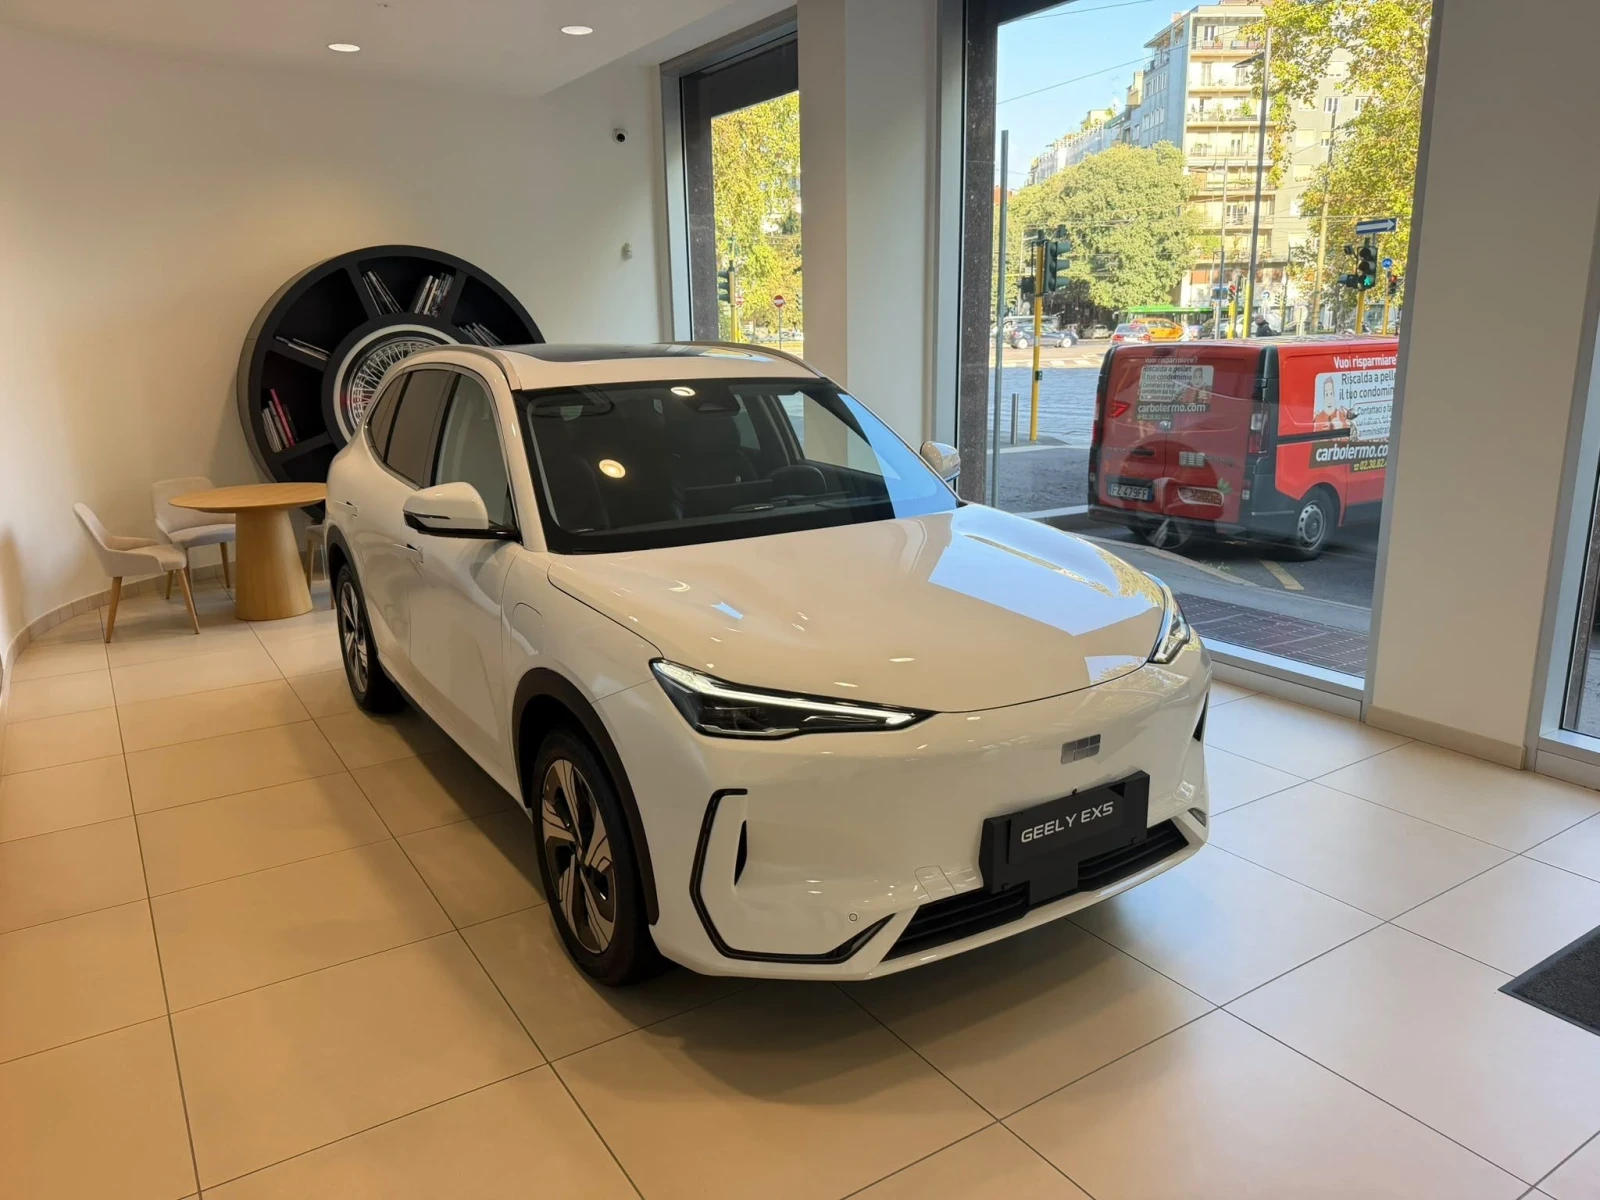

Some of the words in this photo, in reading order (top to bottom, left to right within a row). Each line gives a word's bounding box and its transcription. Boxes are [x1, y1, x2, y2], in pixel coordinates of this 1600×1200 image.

[1333, 356, 1351, 369] Vuoi
[1341, 372, 1373, 385] Riscalda
[1374, 375, 1379, 383] a
[1339, 388, 1345, 401] il
[1346, 389, 1357, 400] tuo
[1137, 403, 1206, 413] carbotermo.com
[1110, 485, 1123, 496] FZ
[1123, 487, 1148, 499] 479FF
[1020, 813, 1077, 843] GEELY
[1080, 801, 1114, 823] EX5
